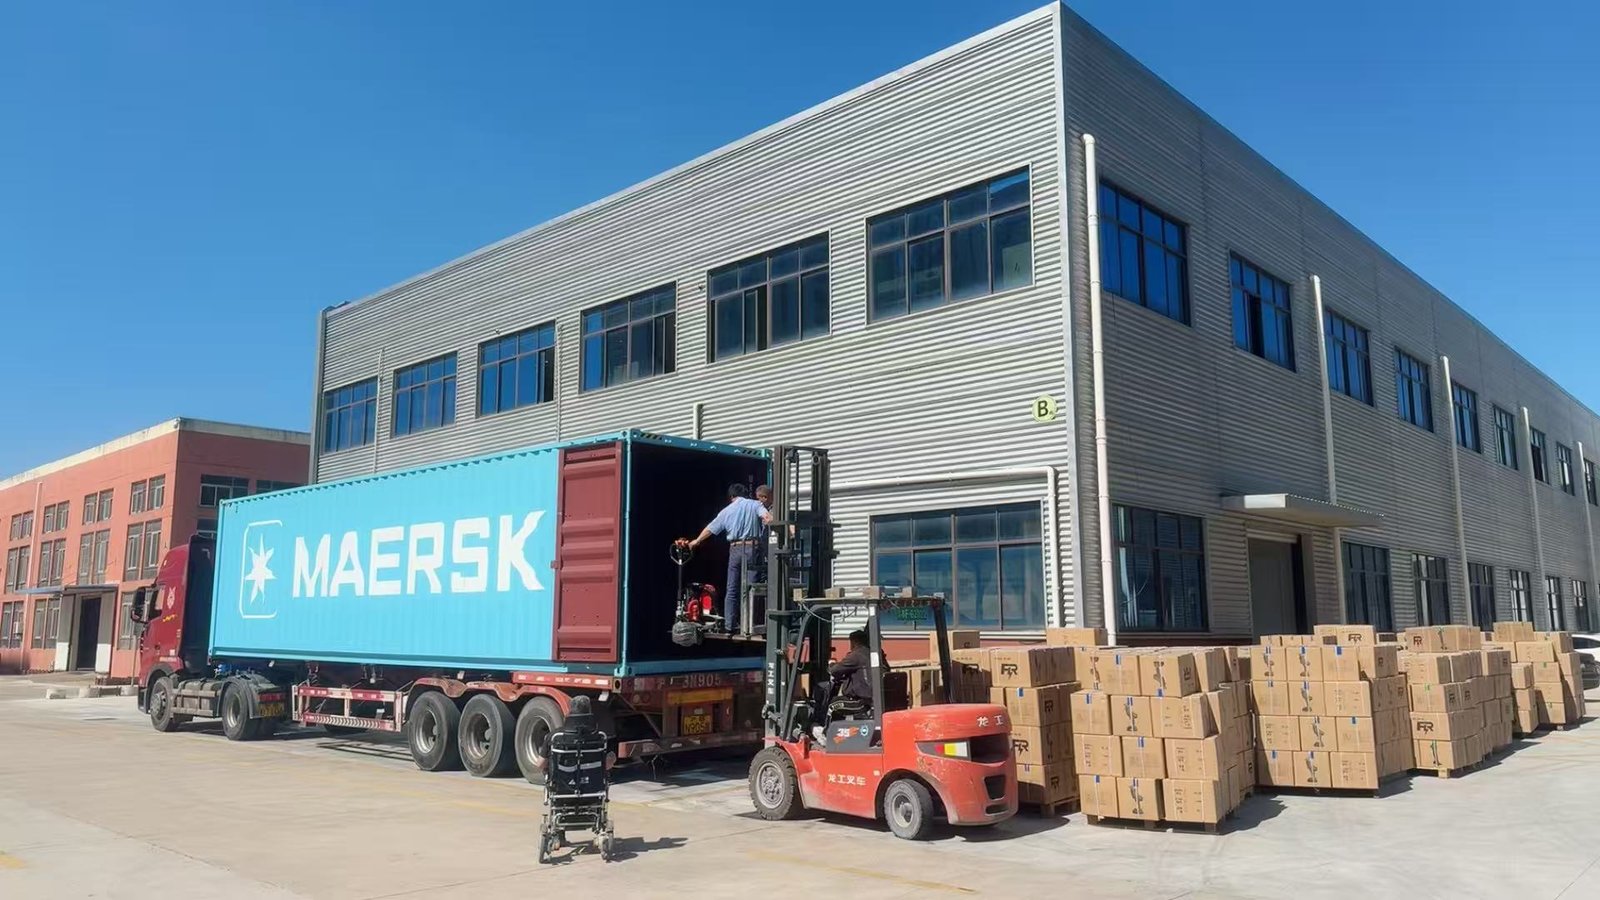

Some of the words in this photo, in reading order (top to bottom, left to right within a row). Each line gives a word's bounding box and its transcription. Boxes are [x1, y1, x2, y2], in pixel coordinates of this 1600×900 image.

[1037, 400, 1049, 417] B
[292, 509, 546, 598] MAERSK
[976, 715, 1004, 727] 龙工
[827, 773, 867, 786] 龙工叉车
